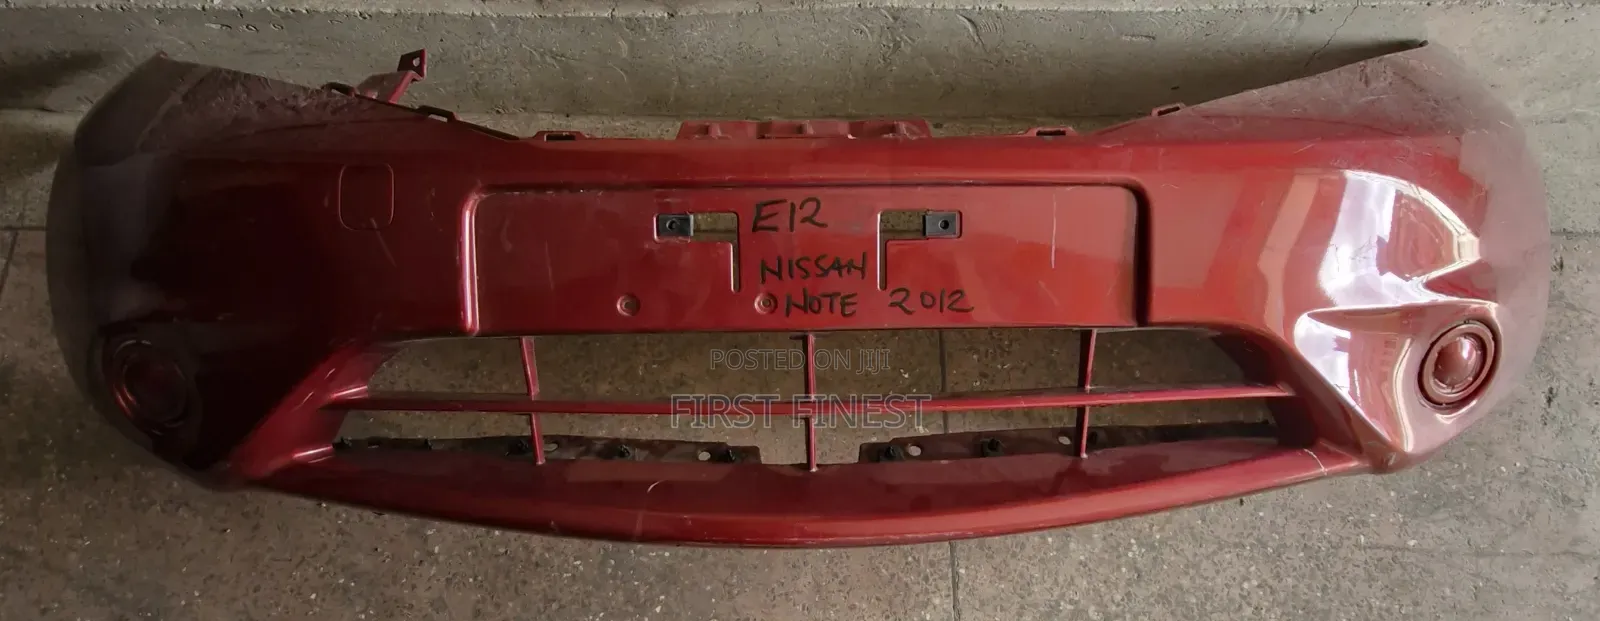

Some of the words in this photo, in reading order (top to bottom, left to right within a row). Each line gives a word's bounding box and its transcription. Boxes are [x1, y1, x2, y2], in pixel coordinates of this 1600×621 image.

[752, 197, 828, 233] E12
[759, 251, 867, 284] NISSAN
[784, 289, 859, 317] NOTE
[889, 287, 975, 315] 2012
